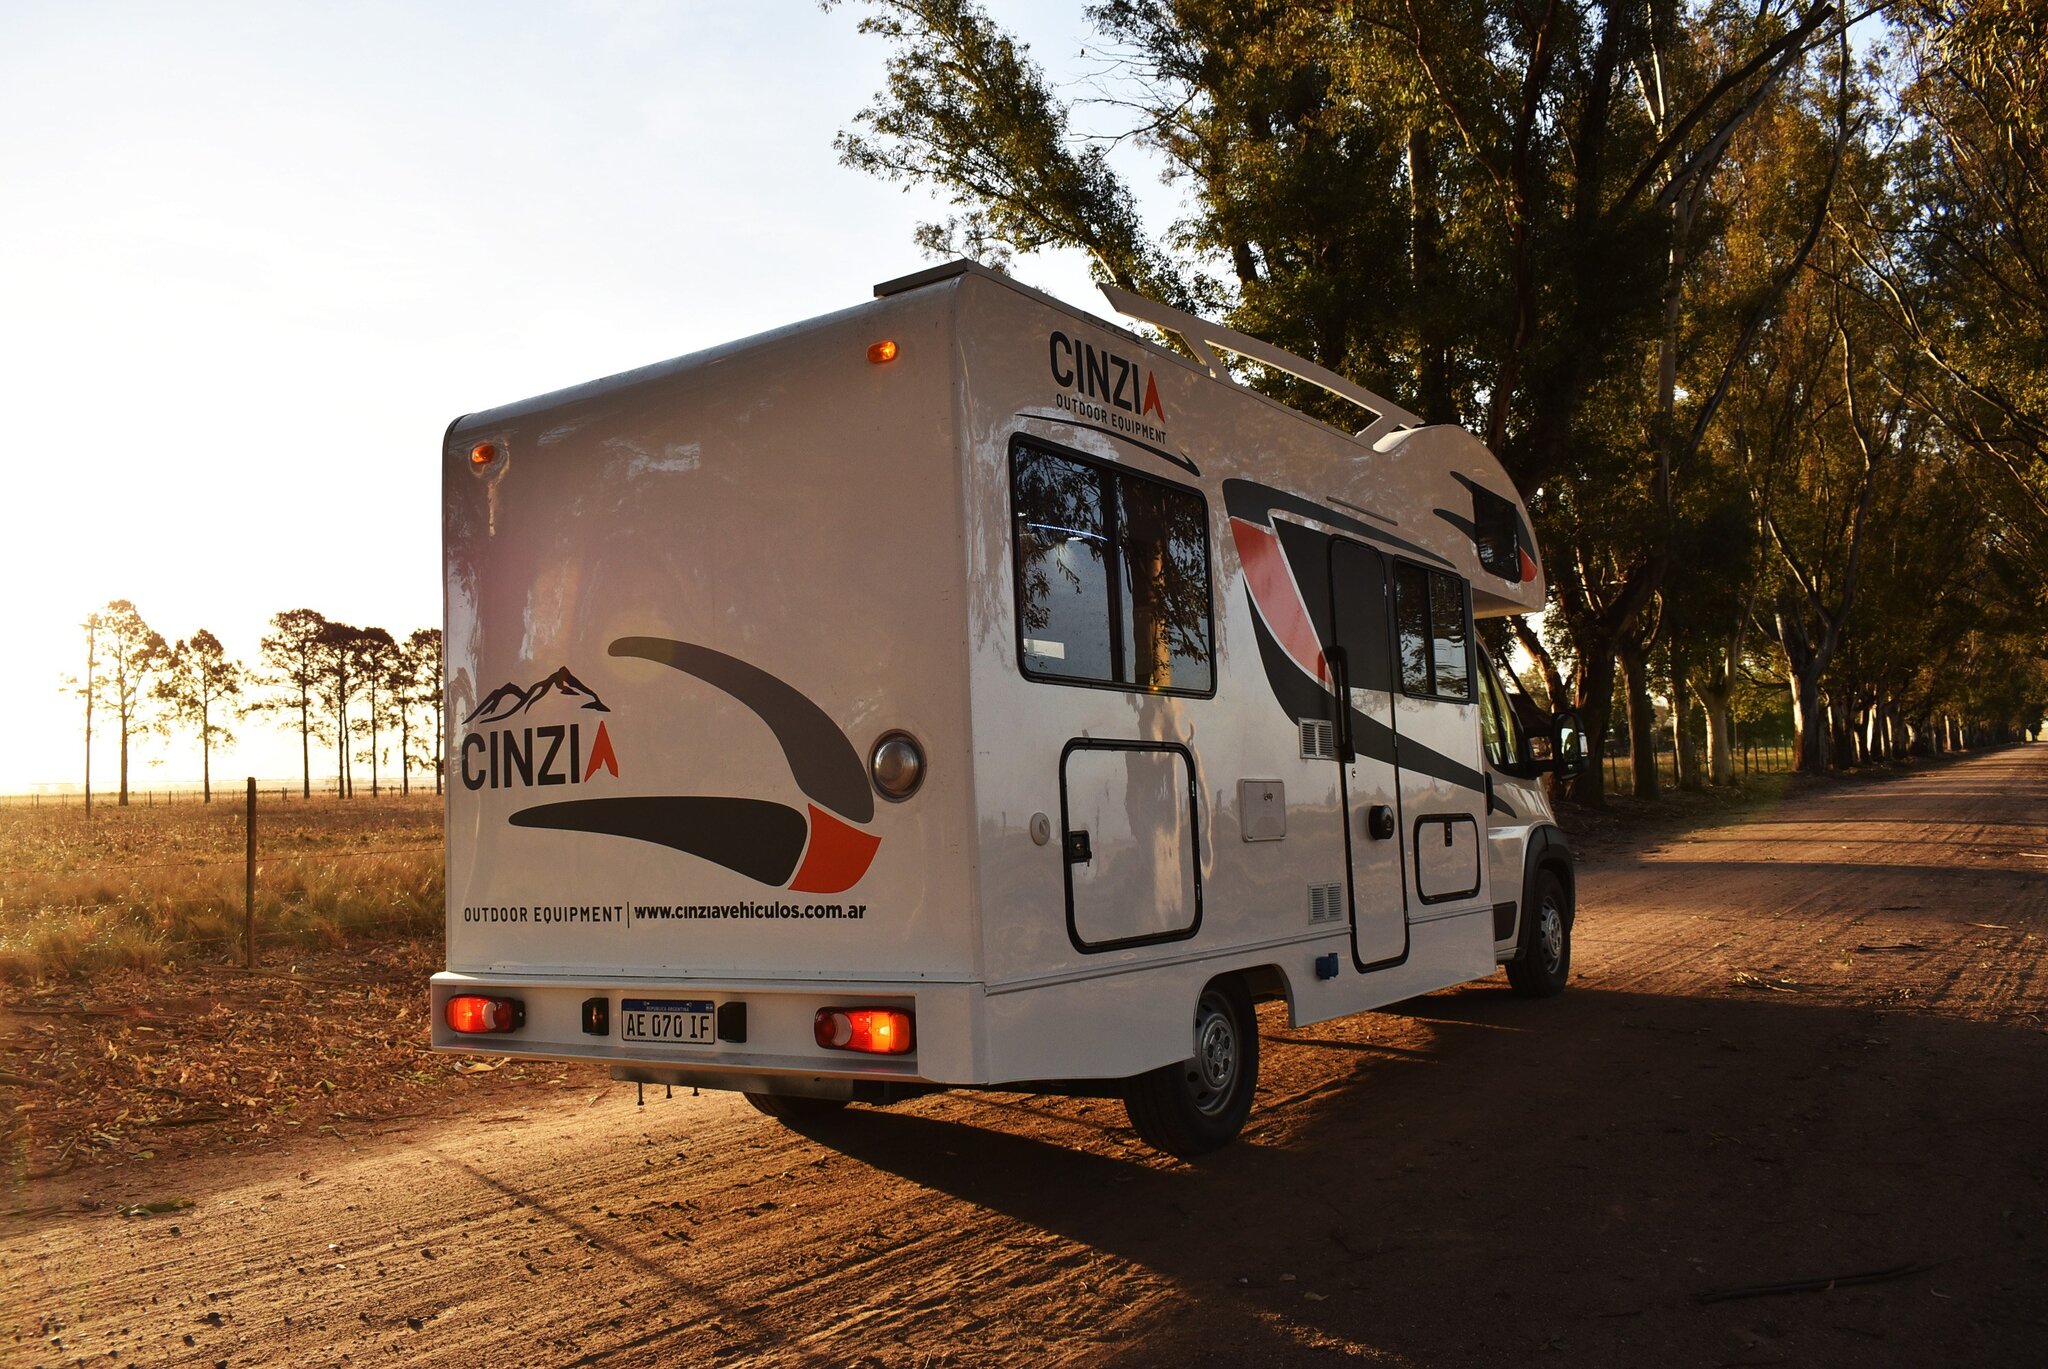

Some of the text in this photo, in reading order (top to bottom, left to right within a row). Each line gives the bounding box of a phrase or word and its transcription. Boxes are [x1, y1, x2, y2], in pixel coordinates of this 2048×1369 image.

[1050, 331, 1166, 424] CINZIA
[1056, 393, 1166, 445] OUTDOOR EQUIPMENT
[461, 720, 619, 791] CINZIA
[464, 906, 623, 924] OUTDOOR EQUIPMENT
[626, 1014, 710, 1039] AE 070 IF
